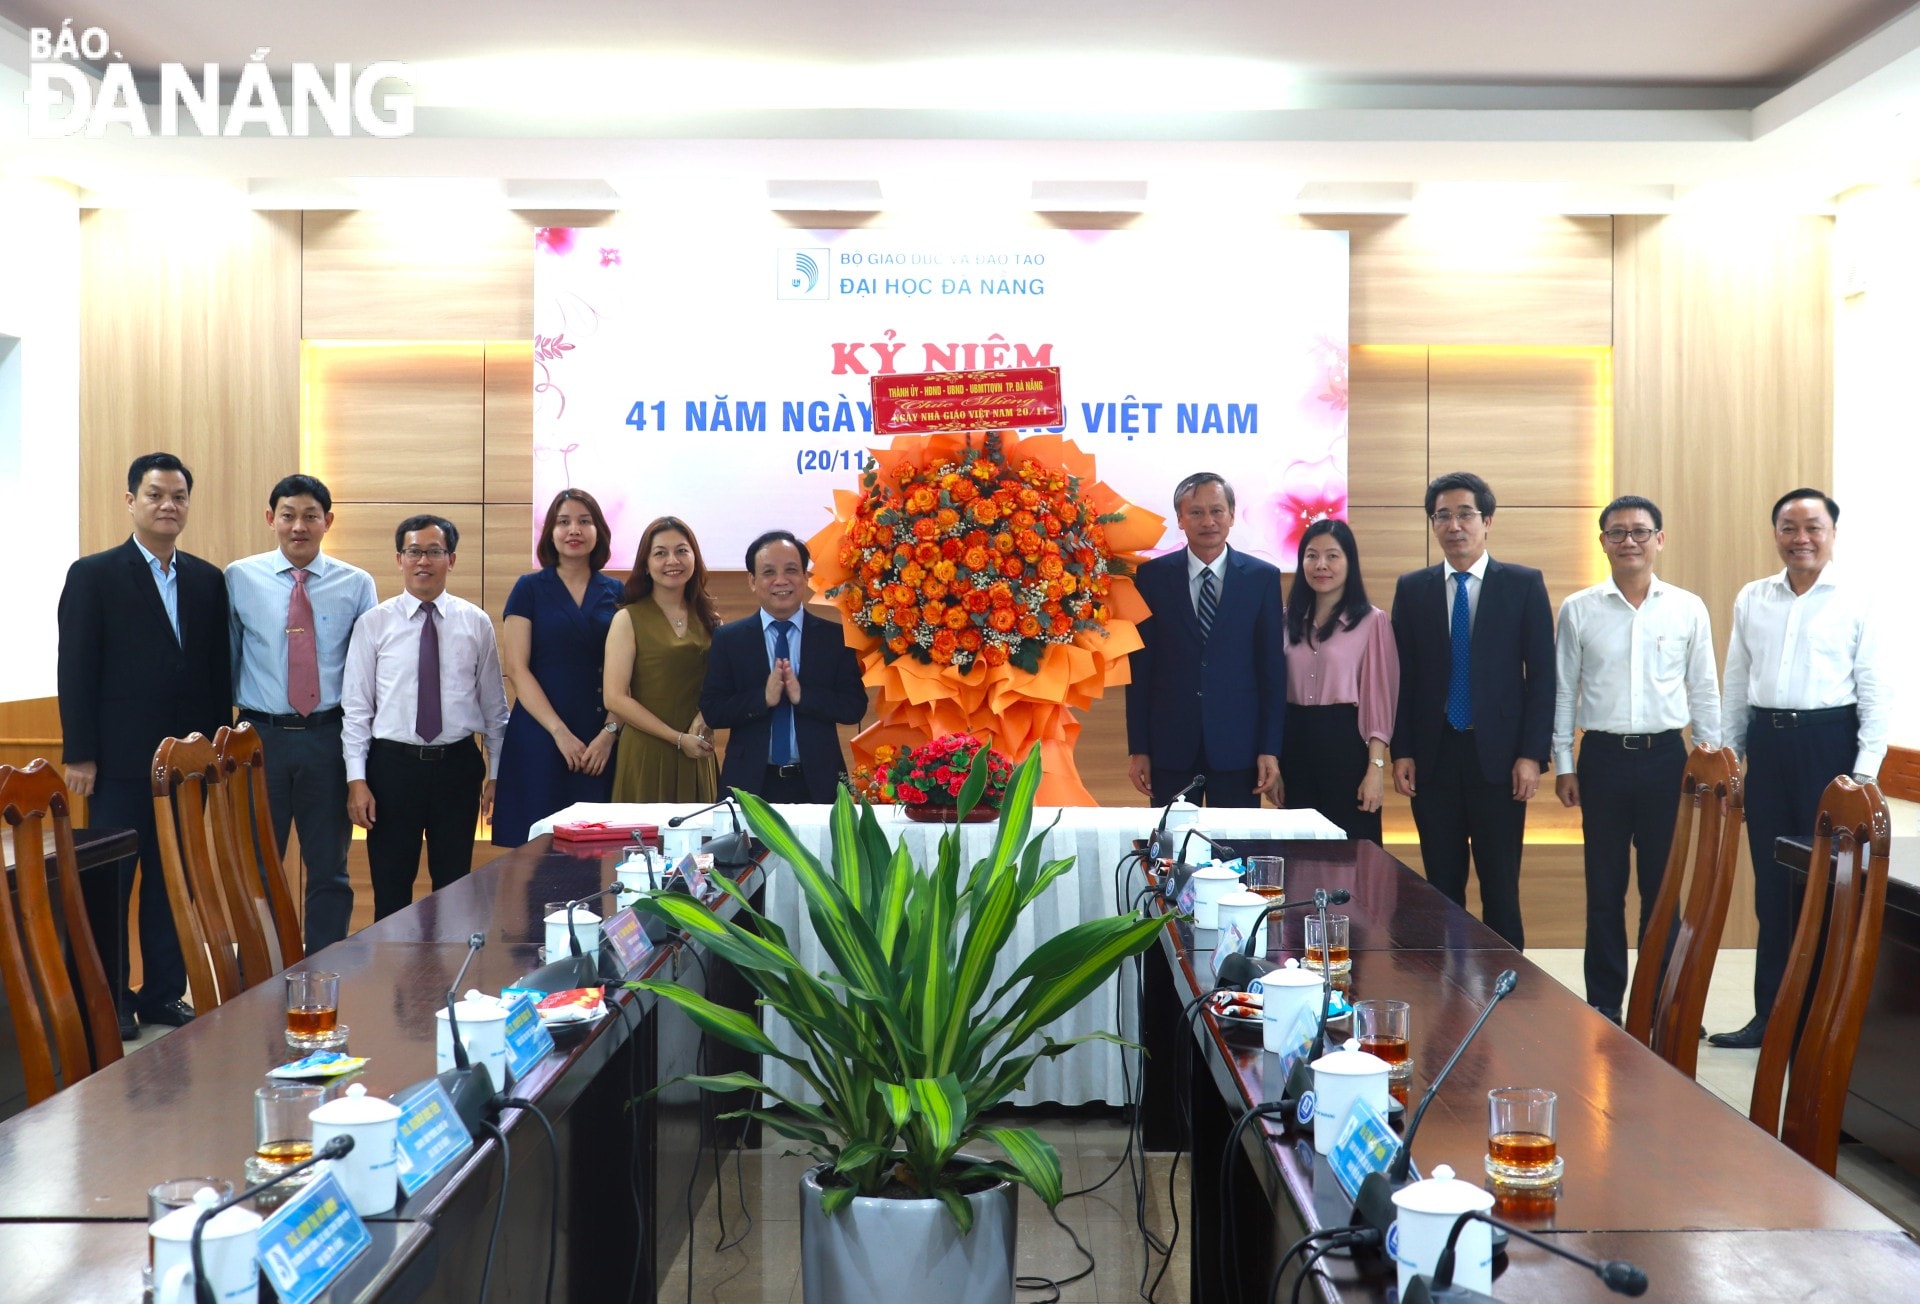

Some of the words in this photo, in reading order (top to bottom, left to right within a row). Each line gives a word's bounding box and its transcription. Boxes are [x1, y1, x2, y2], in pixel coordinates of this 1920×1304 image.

[840, 249, 863, 267] BỘ
[840, 278, 877, 298] ĐẠI
[885, 278, 932, 298] HỌC
[831, 329, 906, 375] KỶ
[888, 385, 910, 398] THÀNH
[1006, 381, 1015, 392] TP.
[625, 400, 665, 432] 41
[685, 394, 766, 432] NĂM
[782, 393, 873, 433] NGÀY
[1081, 394, 1163, 441] VIỆT
[1176, 402, 1258, 434] NAM
[920, 410, 940, 422] NHÀ
[943, 409, 966, 420] GIÁO
[968, 407, 990, 419] VIỆT
[992, 408, 1014, 418] NAM
[1016, 406, 1048, 417] 20/11
[796, 449, 863, 475] (20/11
